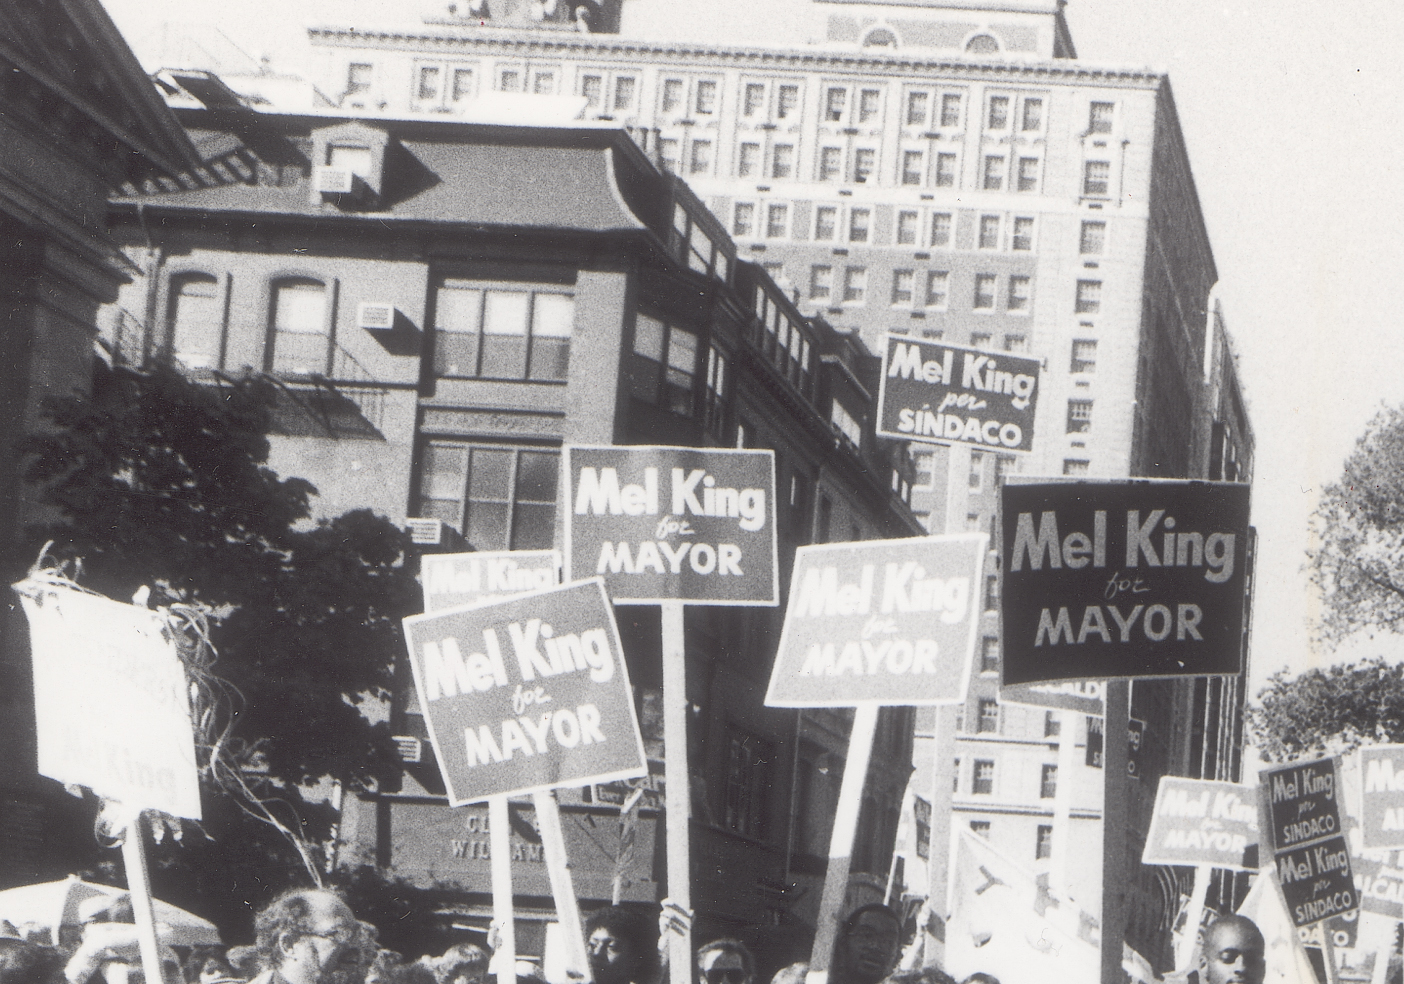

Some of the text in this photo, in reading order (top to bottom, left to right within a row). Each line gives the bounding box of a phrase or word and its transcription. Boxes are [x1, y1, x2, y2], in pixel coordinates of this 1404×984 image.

[888, 343, 1035, 410] Mel King
[938, 392, 987, 413] per
[574, 466, 766, 531] Mel King
[656, 516, 696, 539] for
[596, 541, 744, 577] MAYOR
[1010, 509, 1236, 583] Mel King
[429, 559, 480, 594] Mel
[794, 561, 970, 624] Mel King
[1105, 572, 1151, 598] for
[861, 614, 899, 639] for
[1033, 603, 1204, 647] MAYOR
[423, 618, 614, 701] Mel King
[799, 639, 938, 677] MAYOR
[512, 683, 552, 715] for
[465, 703, 607, 769] MAYOR
[1273, 767, 1333, 803] Mel King
[1159, 789, 1210, 818] Mel
[1163, 828, 1247, 854] MAYOR
[1279, 850, 1313, 884] Mel
[1313, 846, 1349, 877] King
